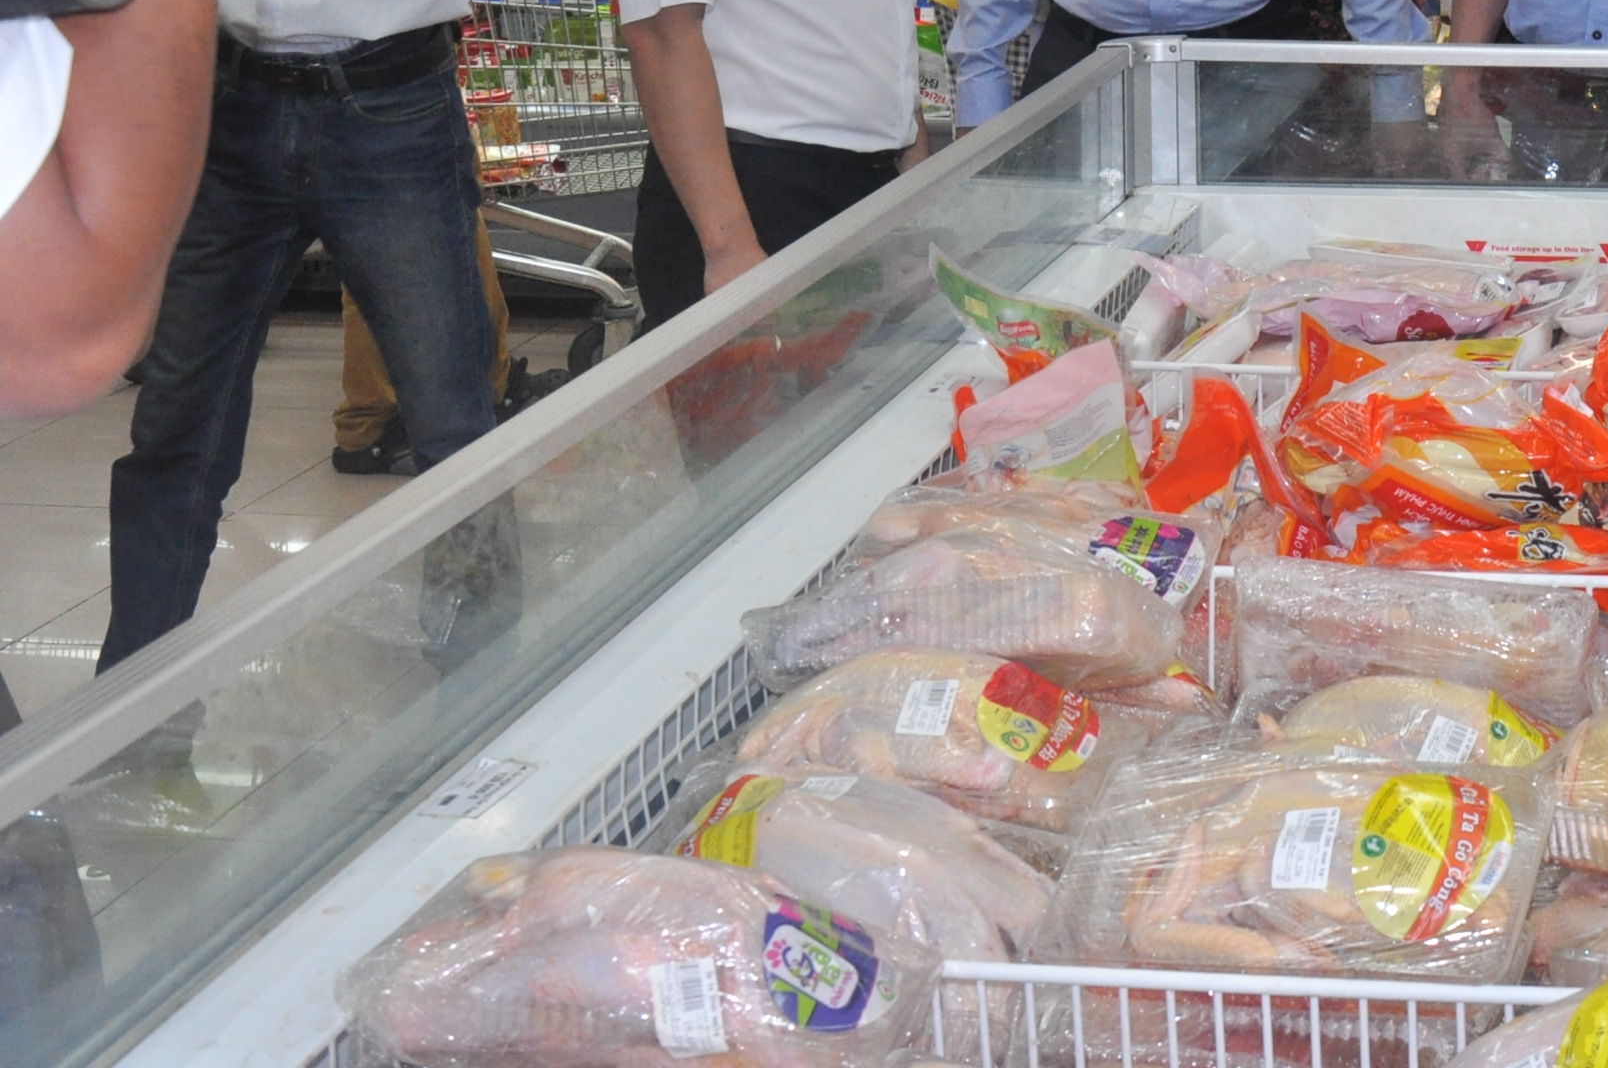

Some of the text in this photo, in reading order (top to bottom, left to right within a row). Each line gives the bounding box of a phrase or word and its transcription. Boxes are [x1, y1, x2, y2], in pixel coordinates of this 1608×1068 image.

[1491, 244, 1510, 253] Food
[1511, 245, 1541, 255] storage
[1542, 247, 1552, 255] up
[1564, 246, 1579, 254] this
[1428, 786, 1487, 914] Gà Ta Gò Công
